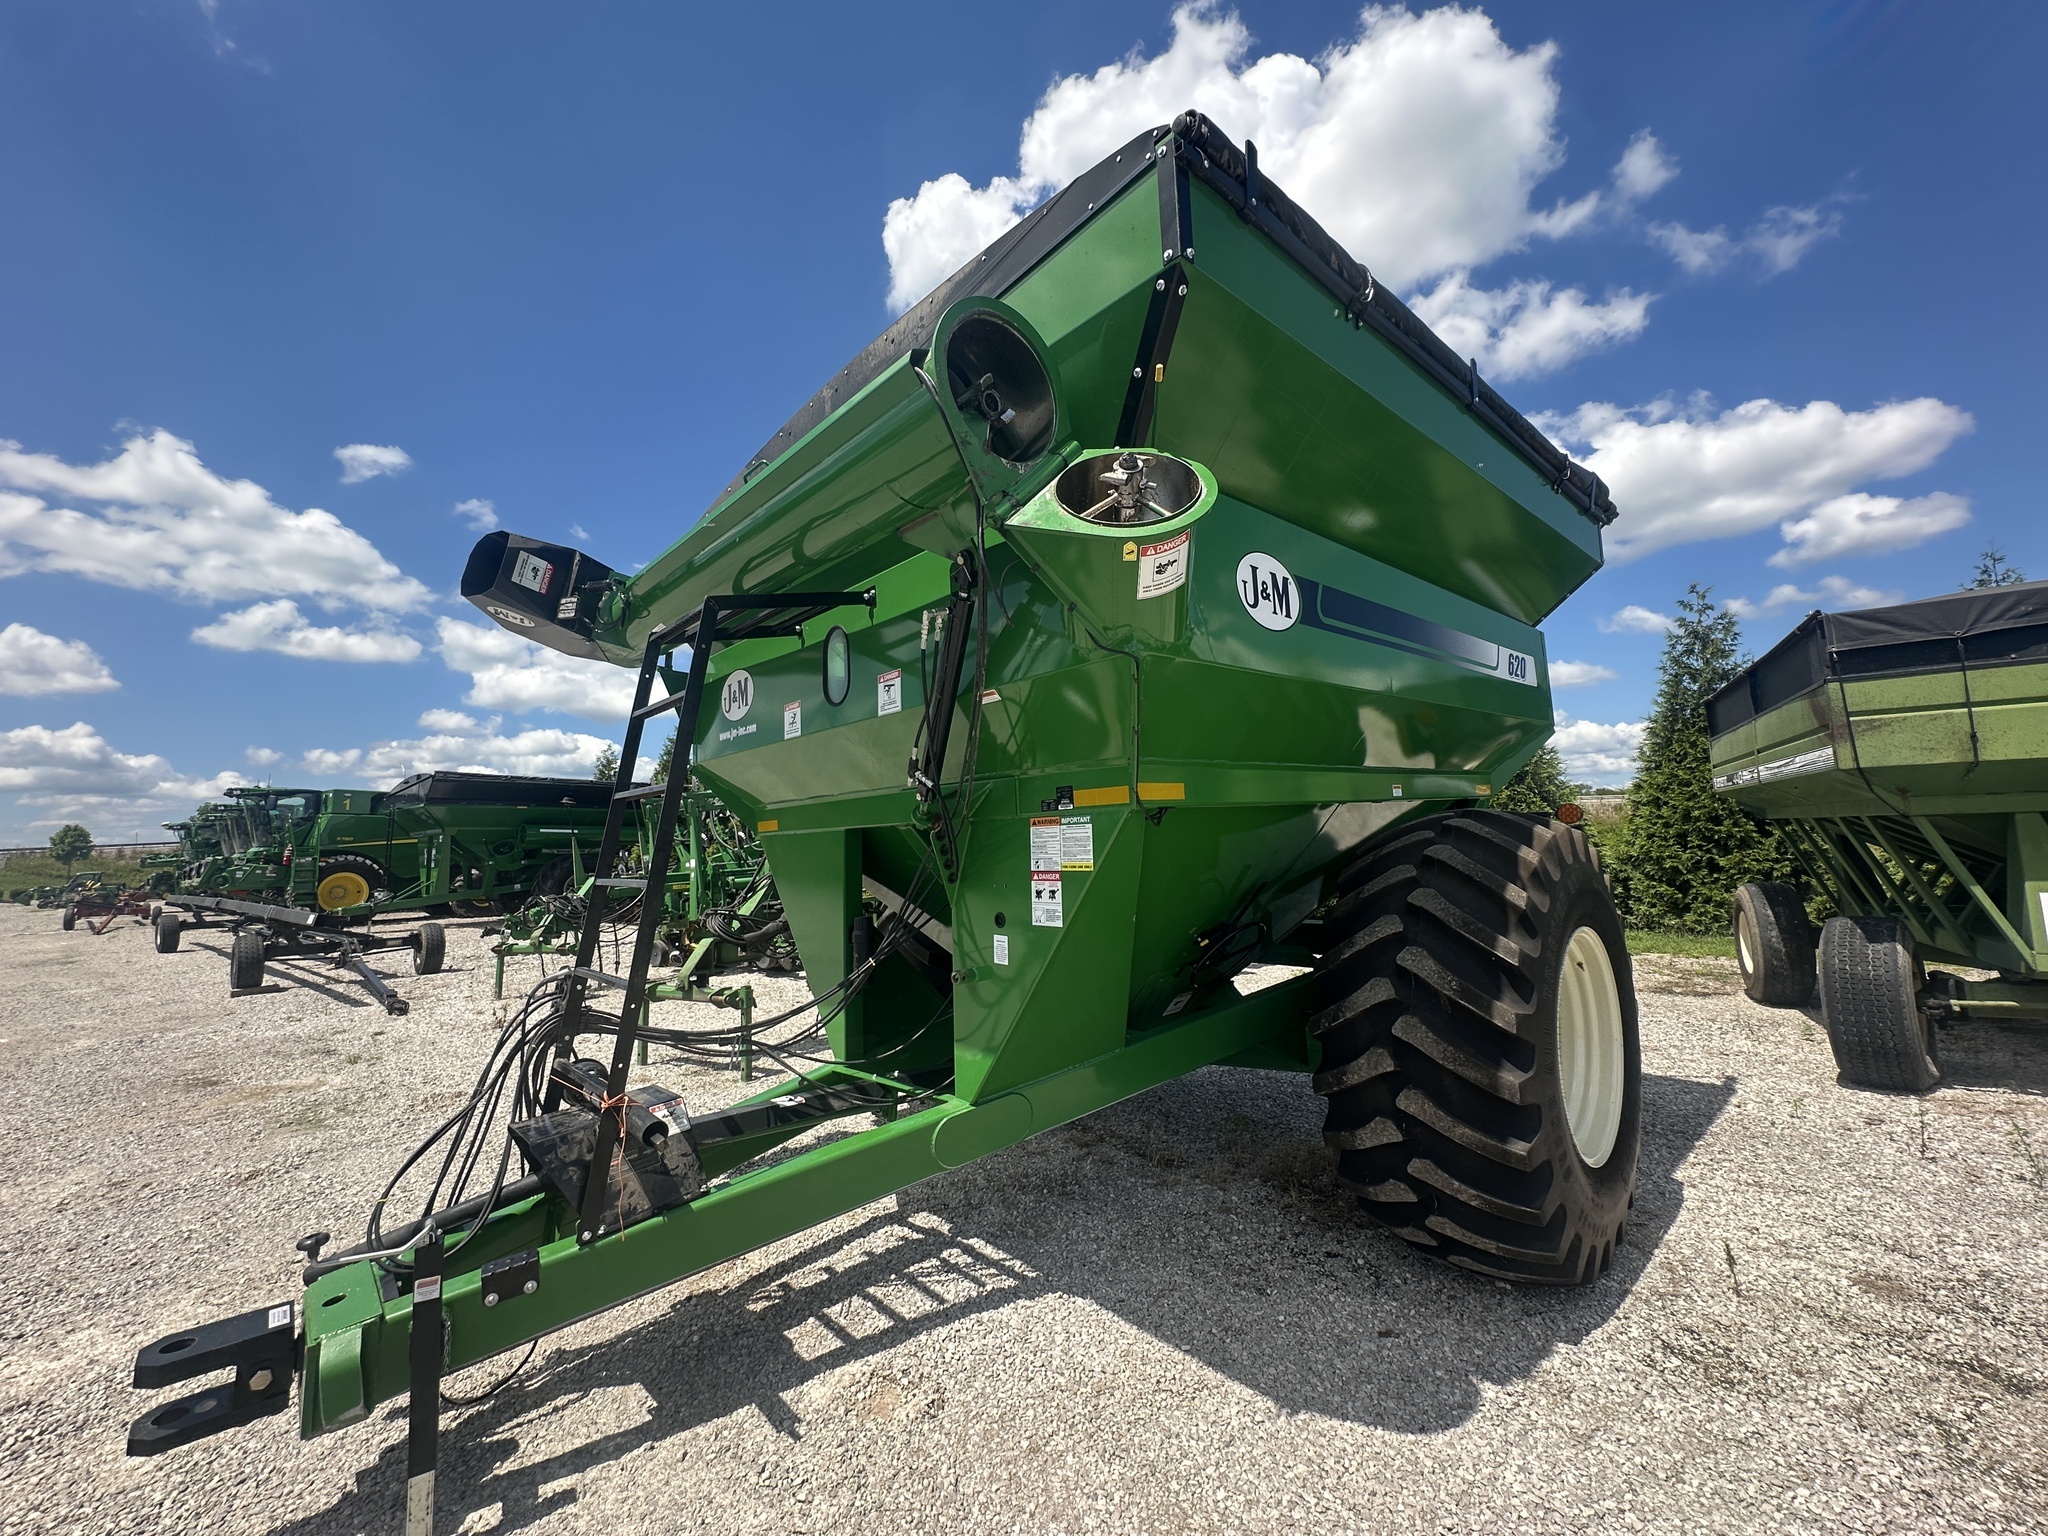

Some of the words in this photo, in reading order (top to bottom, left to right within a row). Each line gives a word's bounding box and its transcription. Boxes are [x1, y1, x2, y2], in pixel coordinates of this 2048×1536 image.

[1156, 534, 1187, 553] DANGER
[540, 567, 552, 594] DANGER
[1241, 564, 1292, 619] J&M
[1508, 653, 1526, 680] 620
[723, 676, 749, 714] J&M
[343, 798, 350, 811] 1
[1061, 816, 1091, 824] IMPORTANT
